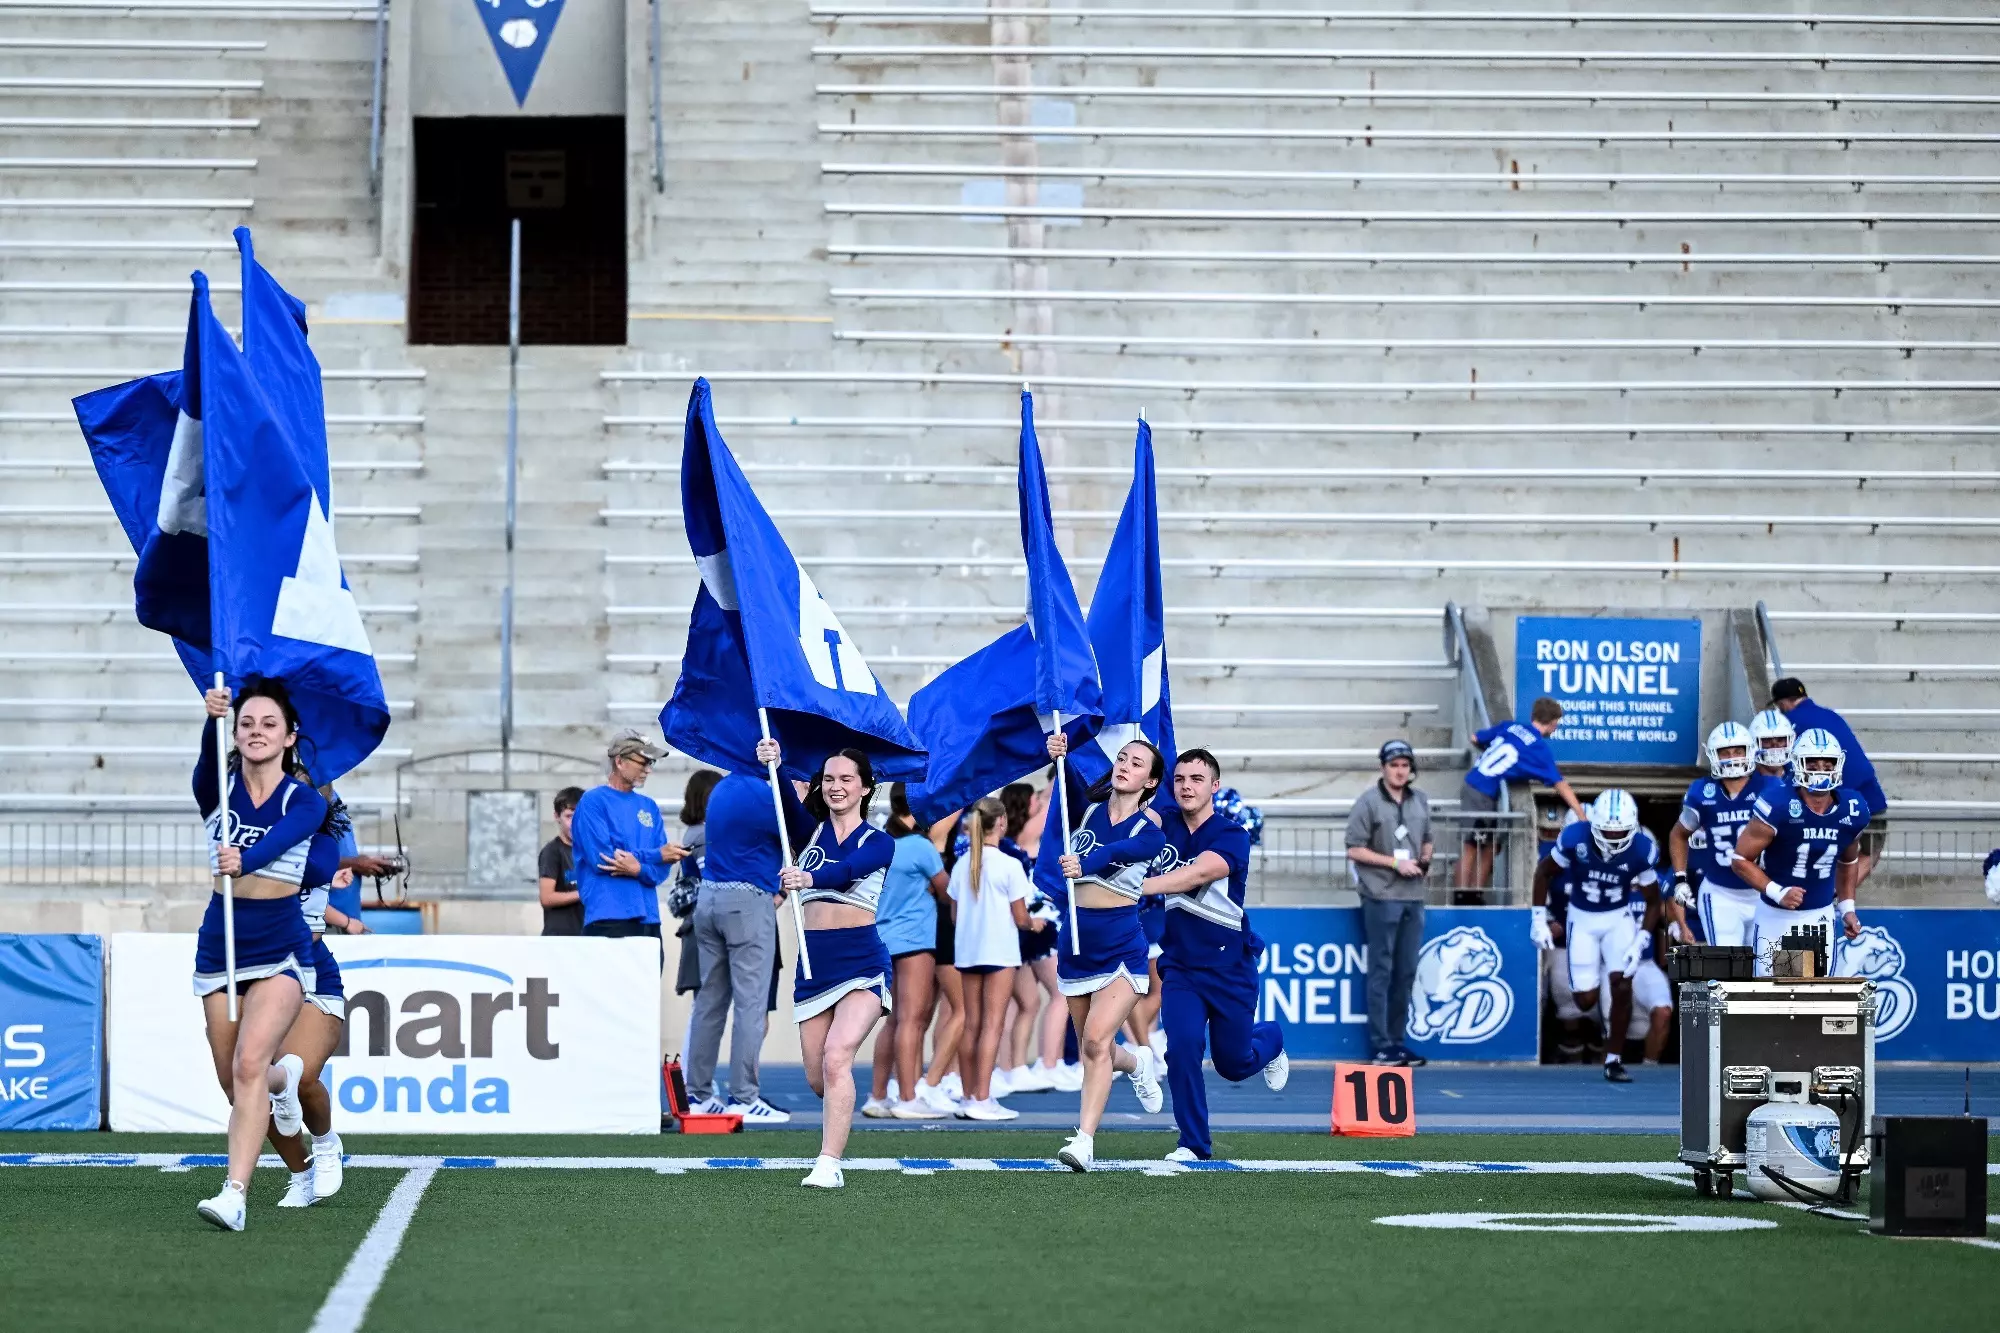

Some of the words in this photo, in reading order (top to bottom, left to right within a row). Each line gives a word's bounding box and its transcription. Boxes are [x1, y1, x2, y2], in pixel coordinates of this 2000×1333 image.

[1536, 639, 1589, 661] RON
[1597, 640, 1680, 664] OLSON
[1536, 663, 1680, 695] TUNNEL
[1558, 714, 1580, 726] ASS
[1582, 714, 1604, 726] THE
[1607, 715, 1664, 728] GREATEST
[1598, 700, 1625, 712] THIS
[1628, 701, 1674, 713] TUNNEL
[1550, 728, 1592, 741] HLETES
[1595, 729, 1609, 741] IN
[1611, 729, 1634, 742] THE
[1637, 730, 1678, 743] WORLD
[1716, 809, 1750, 823] DRAKE
[1848, 798, 1860, 817] C
[1710, 824, 1747, 867] 5
[1803, 827, 1839, 841] DRAKE
[1791, 842, 1839, 880] 14
[1946, 949, 2000, 979] HO
[1254, 978, 1369, 1024] NEL
[0, 1024, 46, 1068] S
[319, 1064, 511, 1114] onda
[1344, 1070, 1408, 1124] 10
